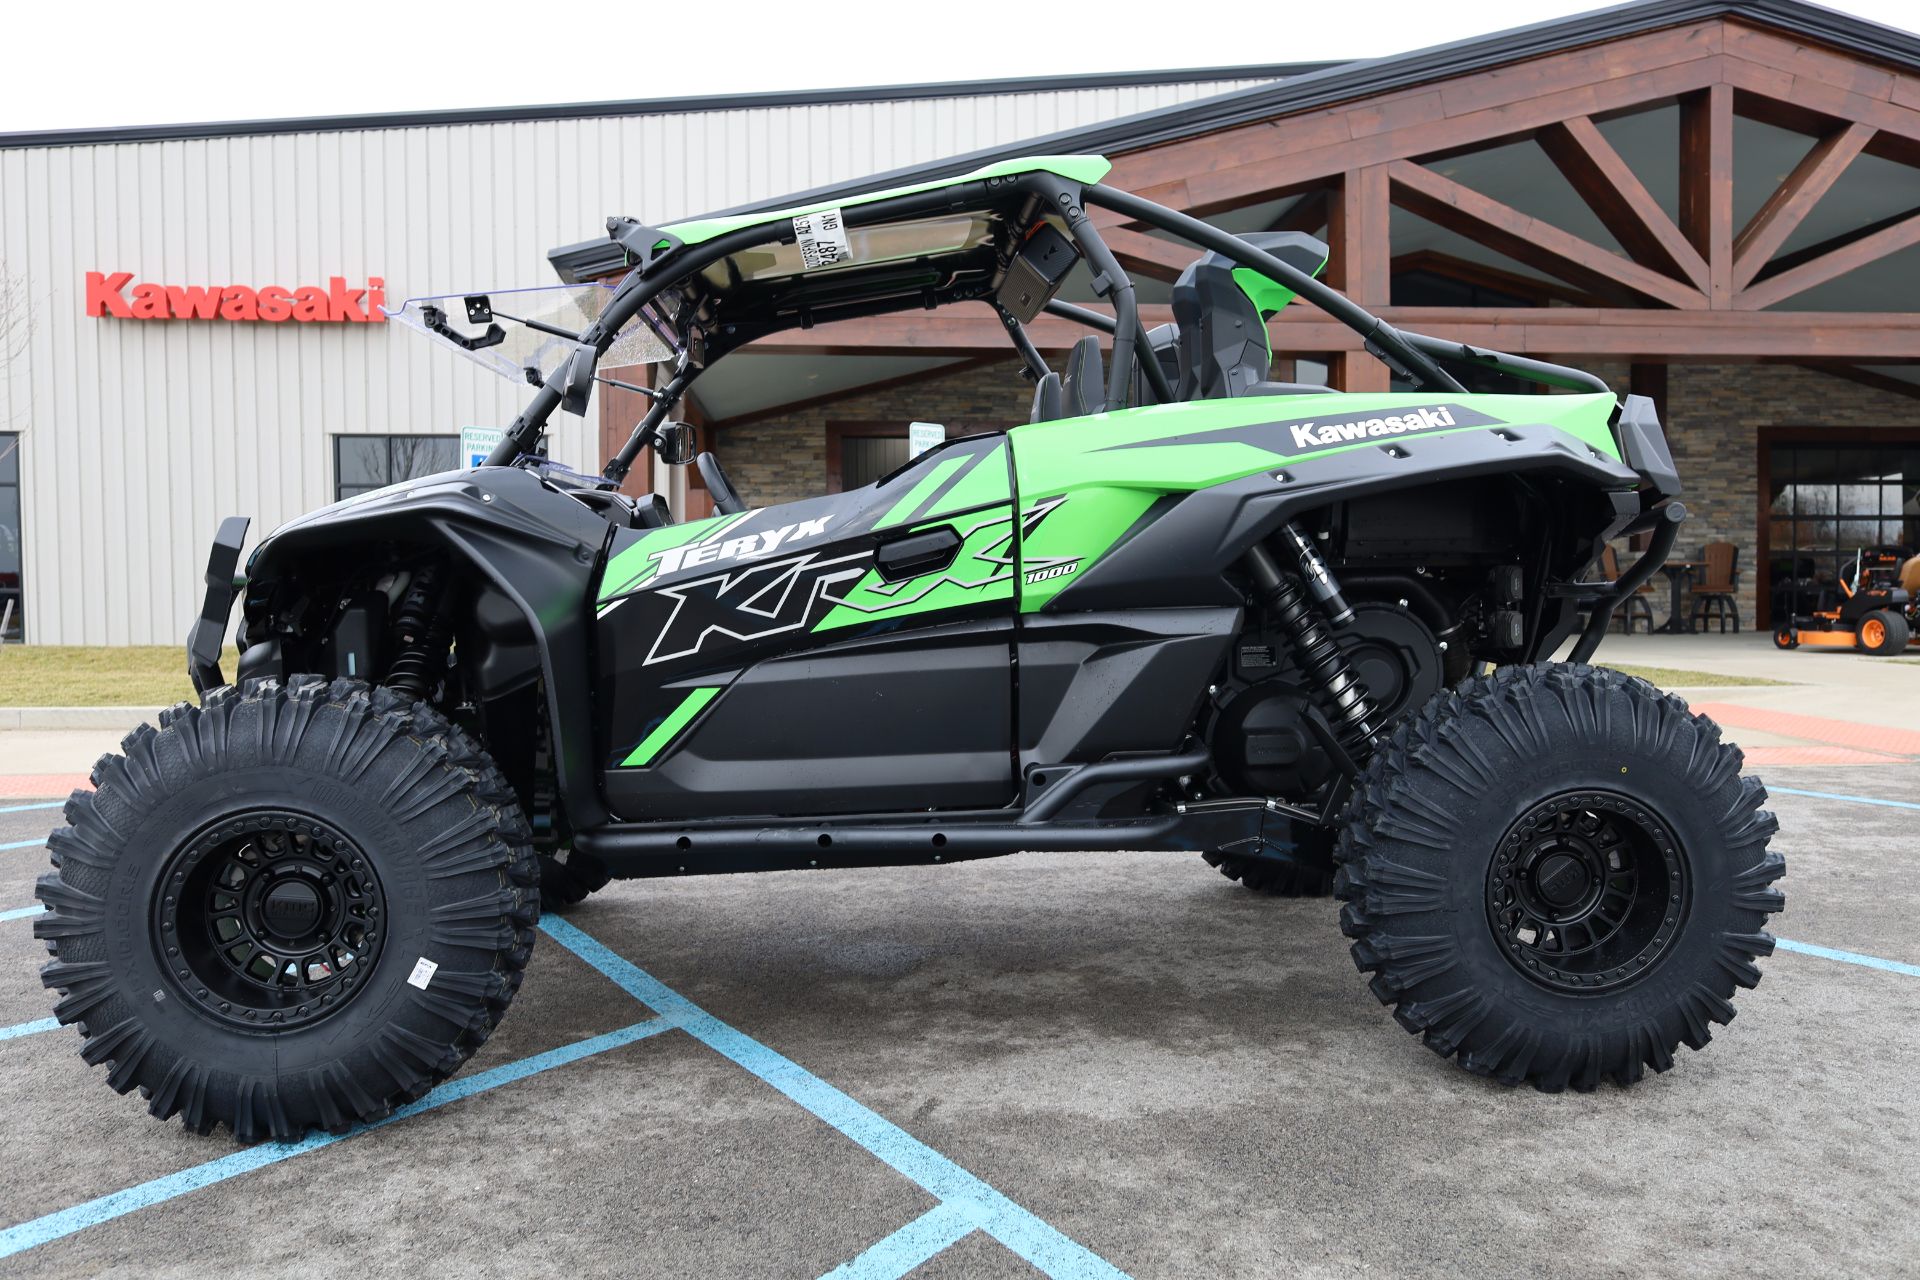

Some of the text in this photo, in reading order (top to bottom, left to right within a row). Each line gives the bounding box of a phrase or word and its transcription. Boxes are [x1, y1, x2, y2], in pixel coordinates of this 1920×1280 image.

[86, 271, 387, 324] Kawasaki
[464, 431, 501, 443] RESERVED
[1289, 405, 1457, 450] Kawasaki
[648, 514, 835, 578] TERYX
[1025, 561, 1079, 585] 1000
